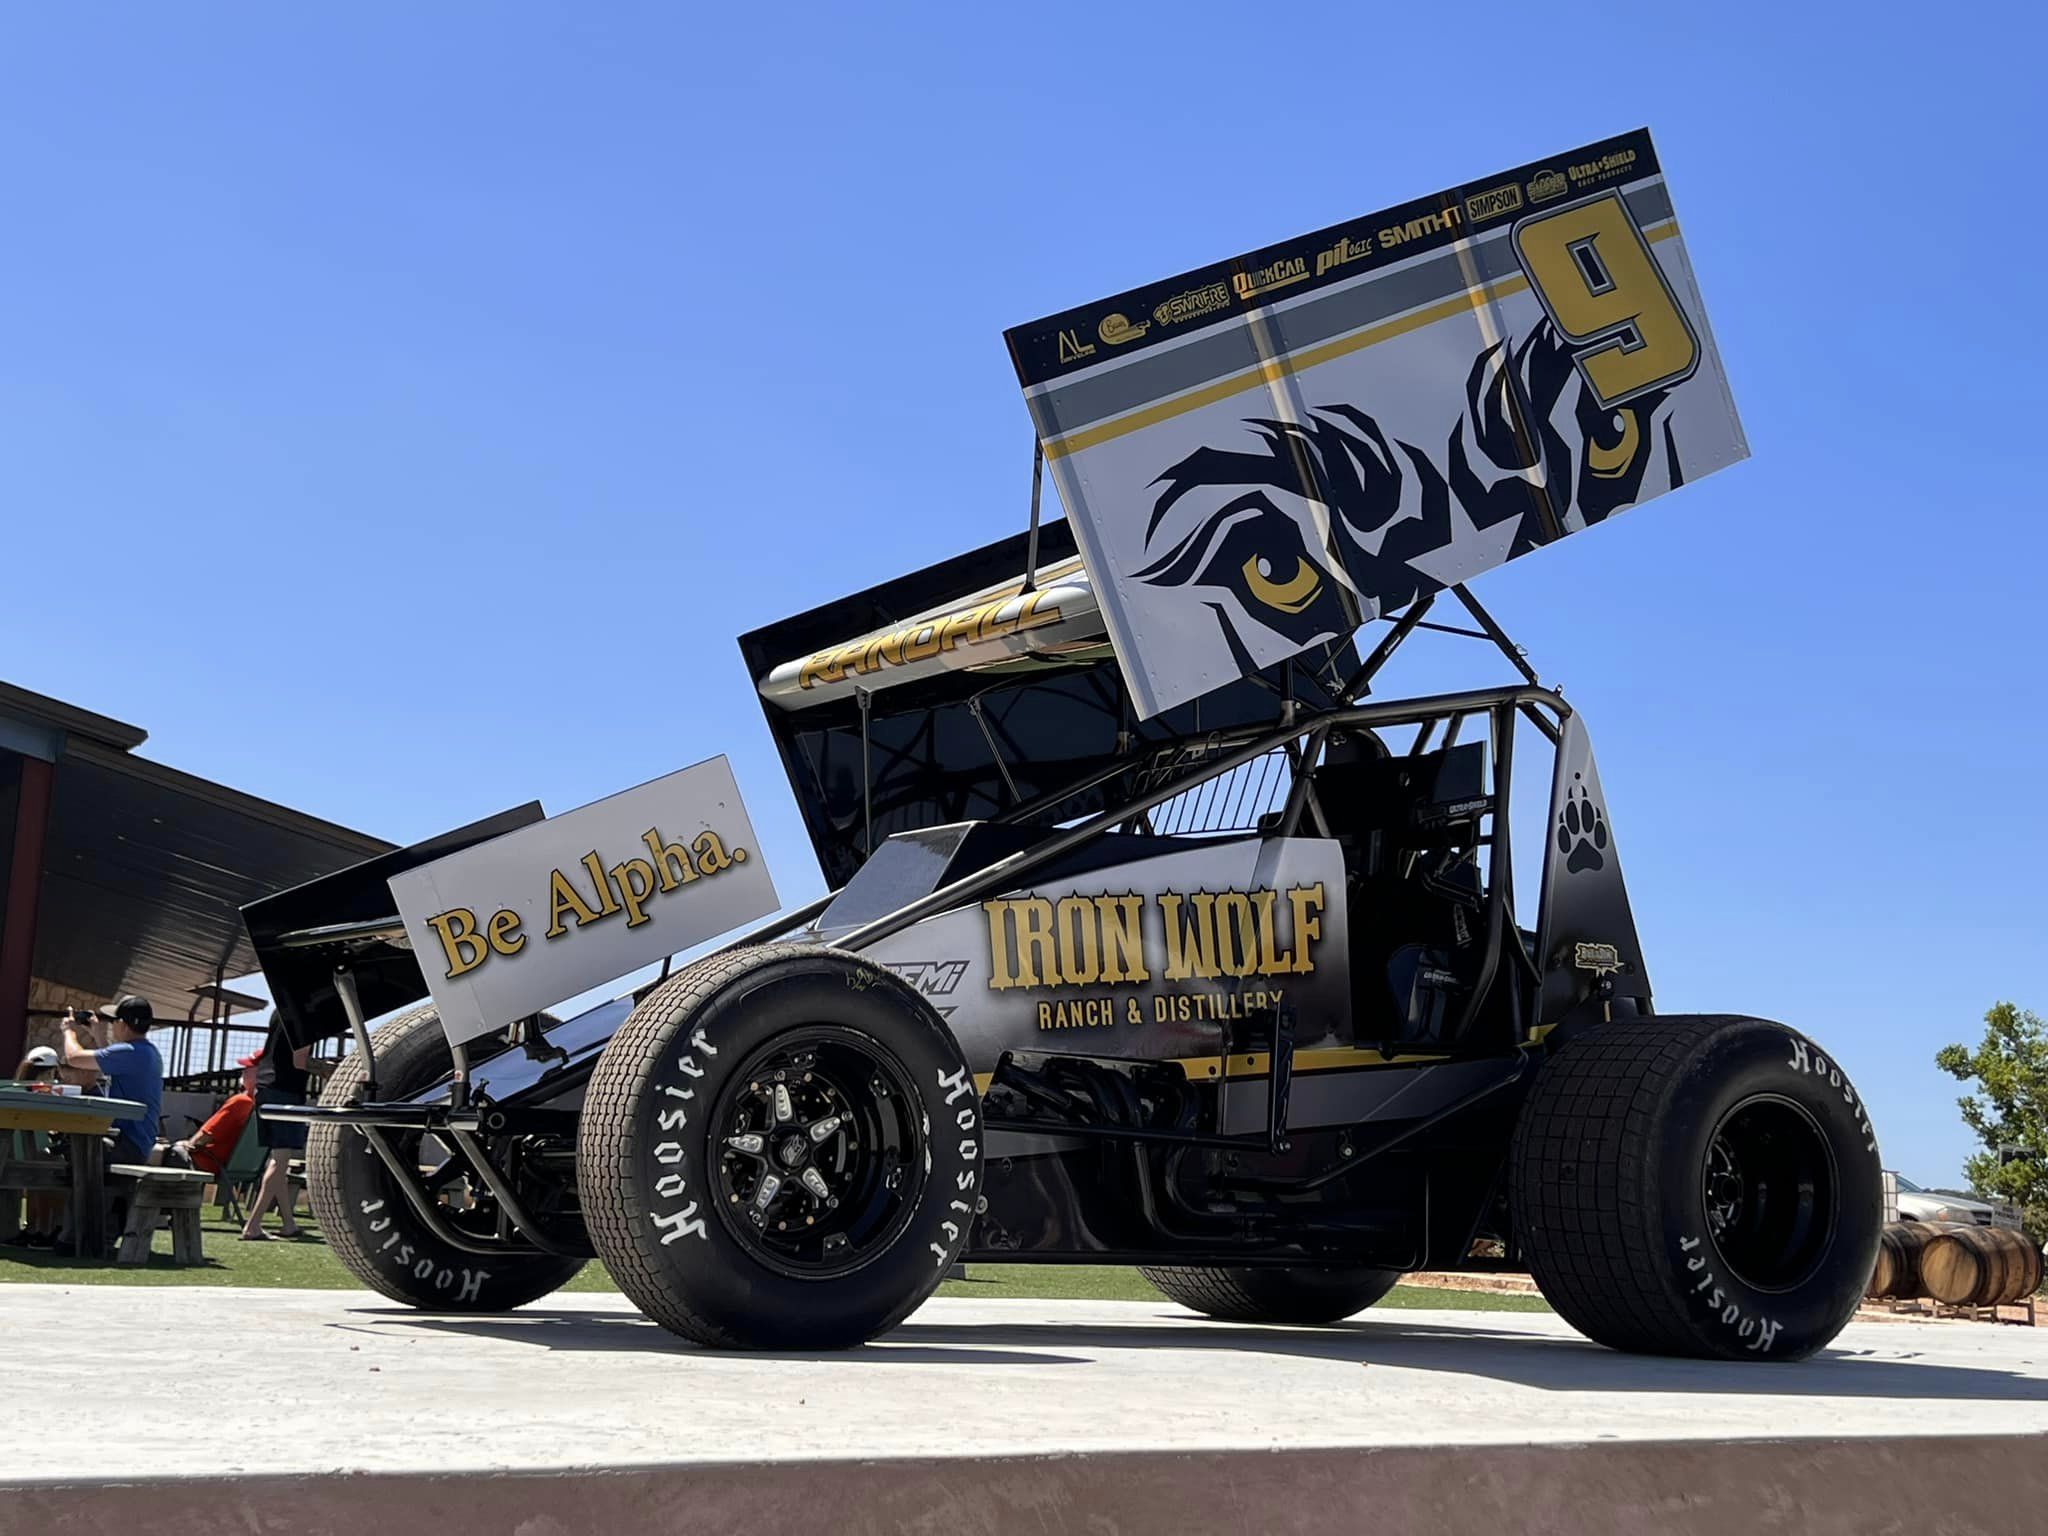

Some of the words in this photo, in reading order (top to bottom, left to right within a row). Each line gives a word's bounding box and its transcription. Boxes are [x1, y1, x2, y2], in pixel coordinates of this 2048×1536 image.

[1469, 187, 1519, 220] SIMPSON
[1511, 186, 1702, 411] 9
[799, 588, 1065, 691] RANDALL
[425, 907, 528, 979] Be
[545, 826, 748, 940] Alpha.
[981, 889, 1150, 992] IRON
[1156, 881, 1326, 984] WOLF
[1038, 998, 1114, 1031] RANCH
[1126, 997, 1143, 1025] &
[650, 1027, 719, 1246] Hoosier
[930, 1064, 976, 1267] Hoosier
[360, 1198, 492, 1301] Hoosier
[1680, 1235, 1784, 1352] Hoosier
